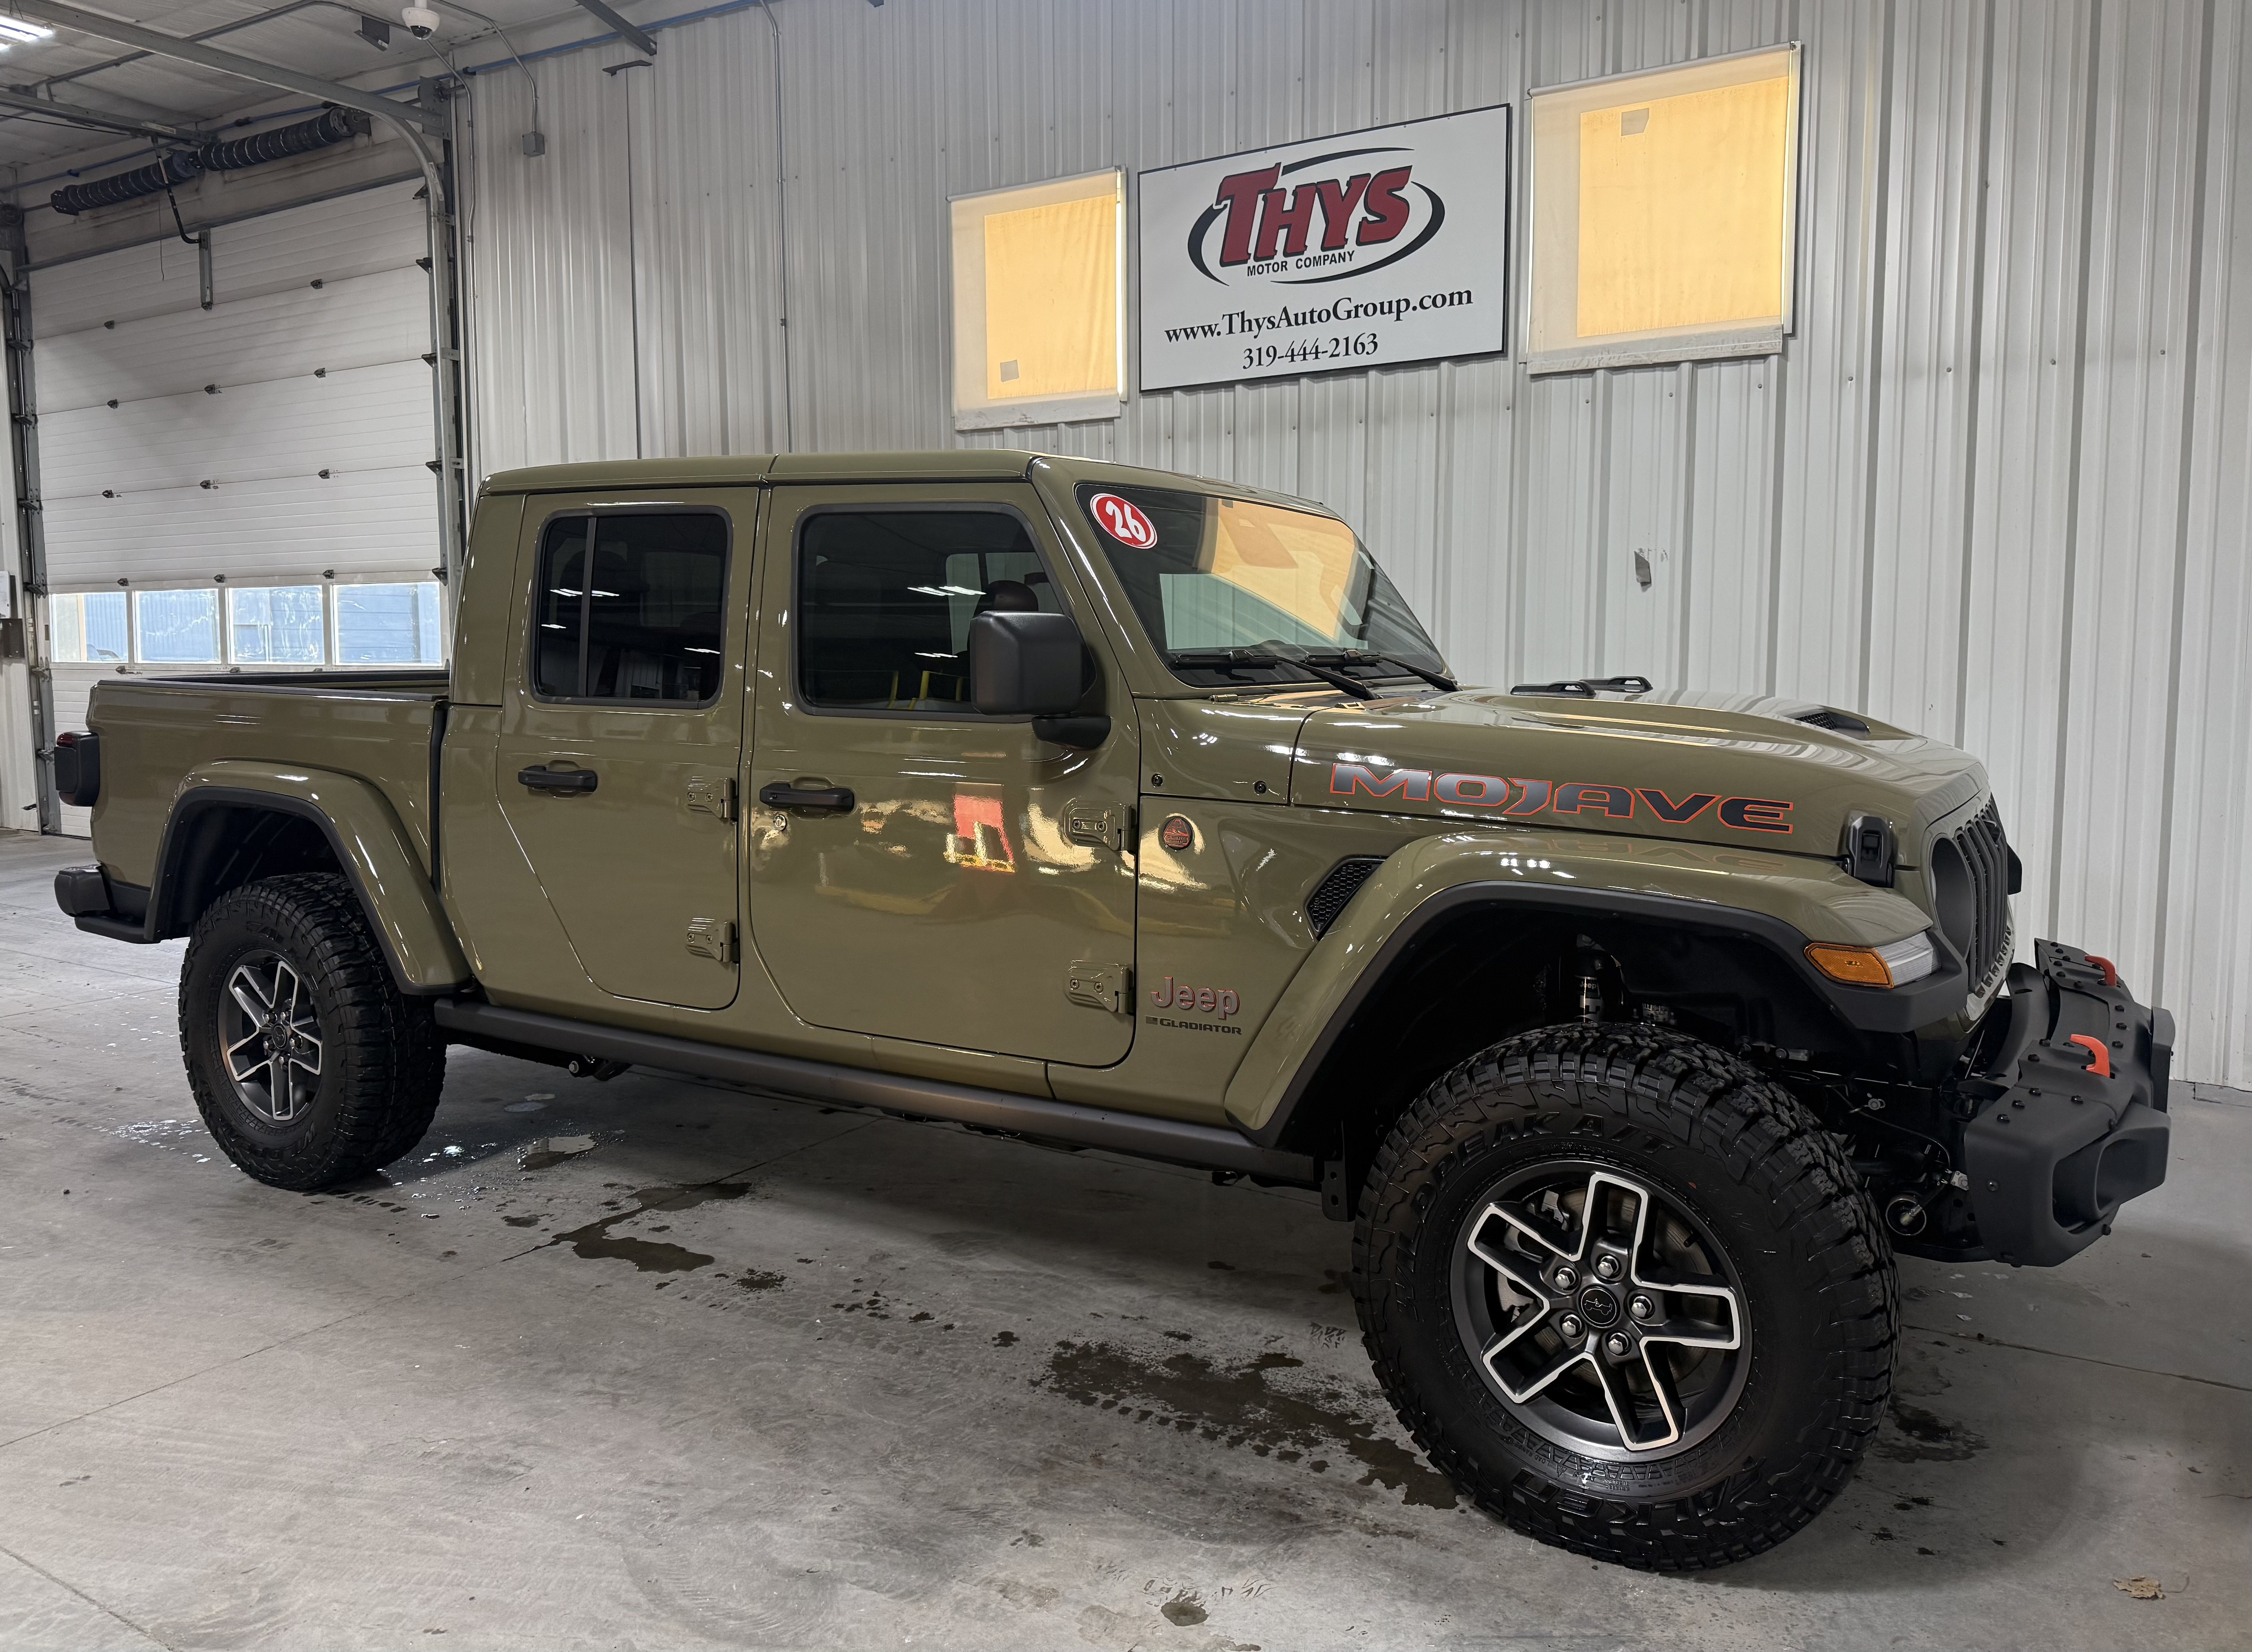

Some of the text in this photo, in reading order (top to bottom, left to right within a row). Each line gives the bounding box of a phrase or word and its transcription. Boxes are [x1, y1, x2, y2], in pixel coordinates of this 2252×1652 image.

[1215, 163, 1413, 267] THYS
[1247, 250, 1355, 277] MOTOR COMPANY
[1165, 289, 1473, 343] www.ThysAutoGroup.com
[1243, 333, 1378, 370] 319-444-2163
[1106, 501, 1146, 542] 26
[1330, 763, 1793, 833] MOJAVE
[1150, 976, 1240, 1021] Jeep
[1160, 1018, 1242, 1035] GLADIATOR
